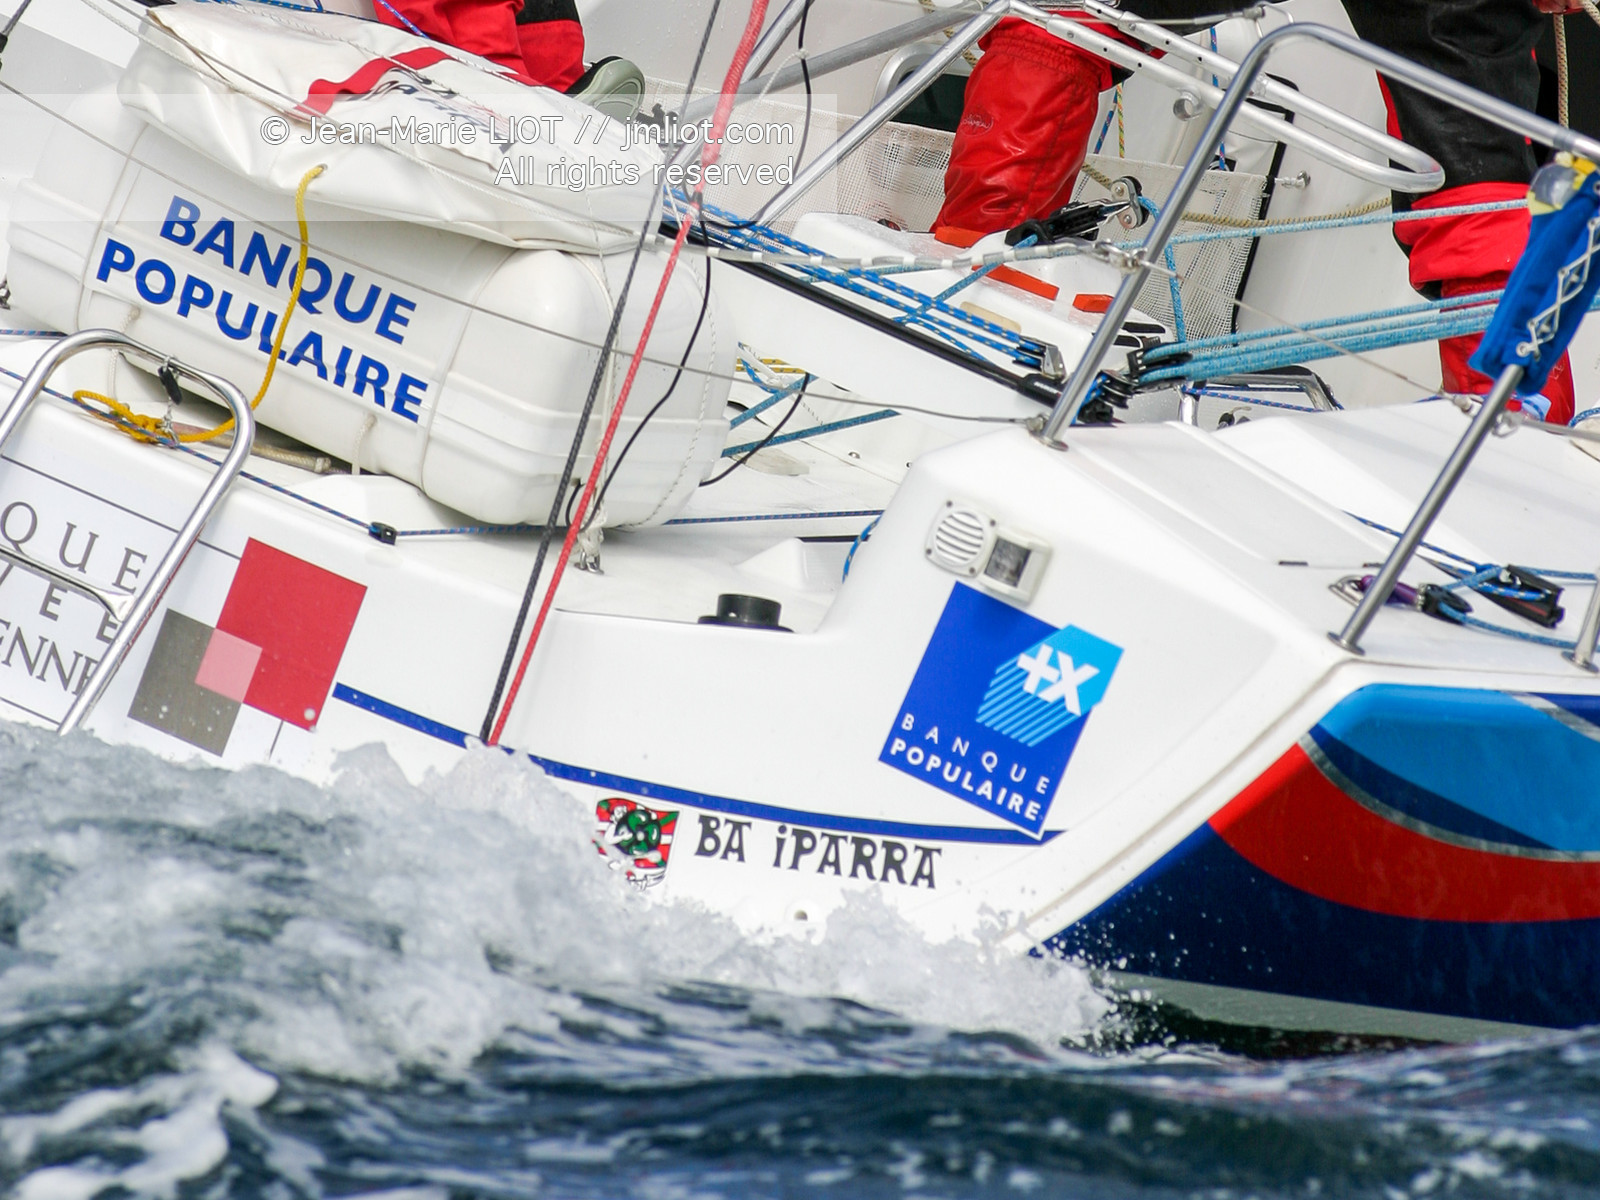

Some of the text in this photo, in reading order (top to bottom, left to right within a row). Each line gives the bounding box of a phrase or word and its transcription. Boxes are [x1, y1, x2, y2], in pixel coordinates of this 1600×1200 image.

[159, 194, 417, 345] BANQUE
[95, 237, 429, 423] POPULAIRE
[889, 737, 1042, 822] POPULAIRE
[901, 712, 1050, 796] BANQUE
[694, 813, 752, 863] BA
